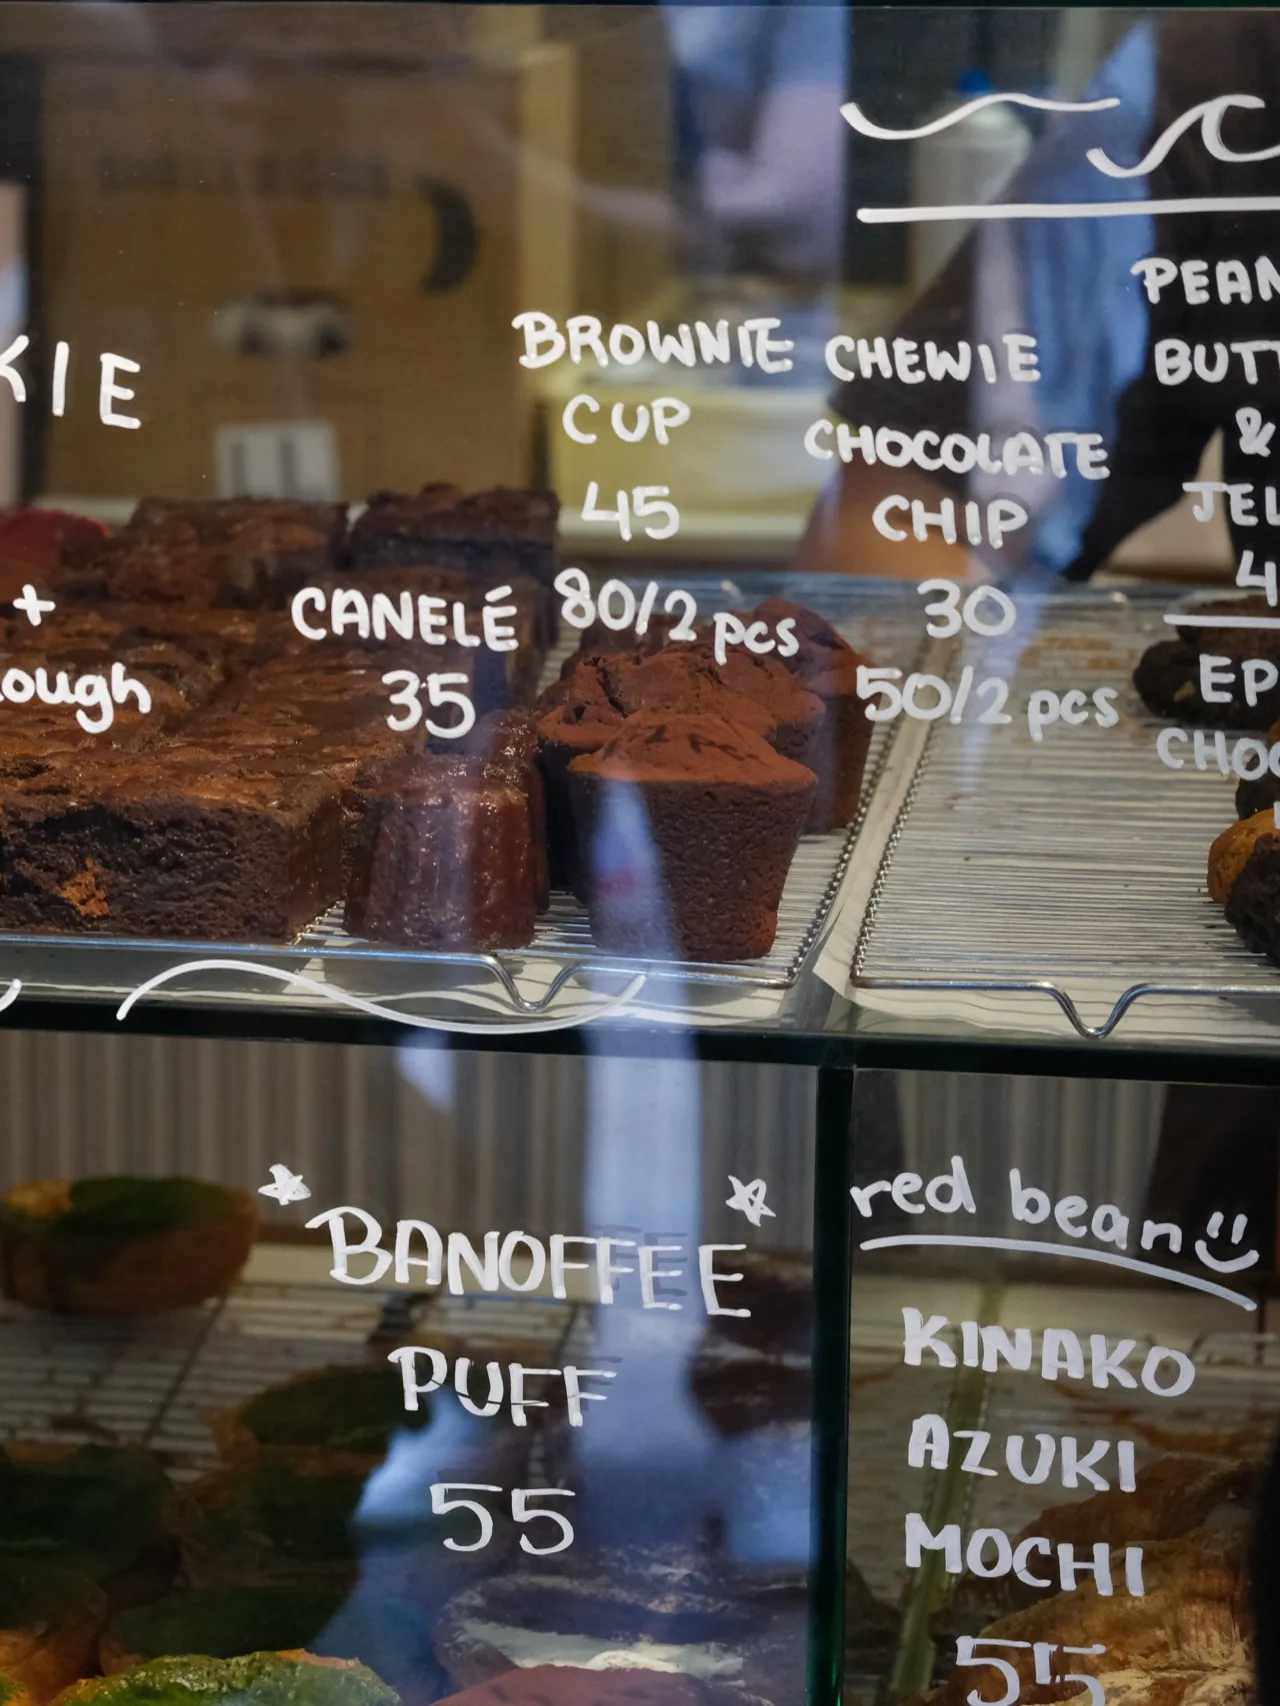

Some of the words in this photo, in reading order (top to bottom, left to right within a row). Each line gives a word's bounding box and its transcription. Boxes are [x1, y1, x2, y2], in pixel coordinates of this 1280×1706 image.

[512, 311, 794, 373] BROWNIE
[825, 334, 1042, 383] CHEWIE
[563, 395, 690, 445] CUP
[803, 420, 1110, 480] CHOCOLATE
[1234, 406, 1276, 457] &
[582, 482, 680, 540] 45
[872, 495, 1028, 547] CHIP
[291, 585, 518, 651] CANELÉ
[553, 568, 697, 643] 80/2
[713, 612, 800, 664] pcs
[916, 578, 1018, 638] 30
[381, 669, 476, 739] 35
[856, 665, 1013, 725] 50/2
[1028, 687, 1120, 741] pcs
[849, 1155, 977, 1218] red
[1009, 1168, 1183, 1255] bean
[305, 1206, 751, 1319] BANOFFEE
[387, 1346, 618, 1428] PUFF
[902, 1306, 1196, 1398] KINAKO
[908, 1413, 1136, 1493] AZUKI
[428, 1483, 577, 1556] 55
[904, 1512, 1145, 1598] MOCHI
[954, 1635, 1108, 1706] 55
